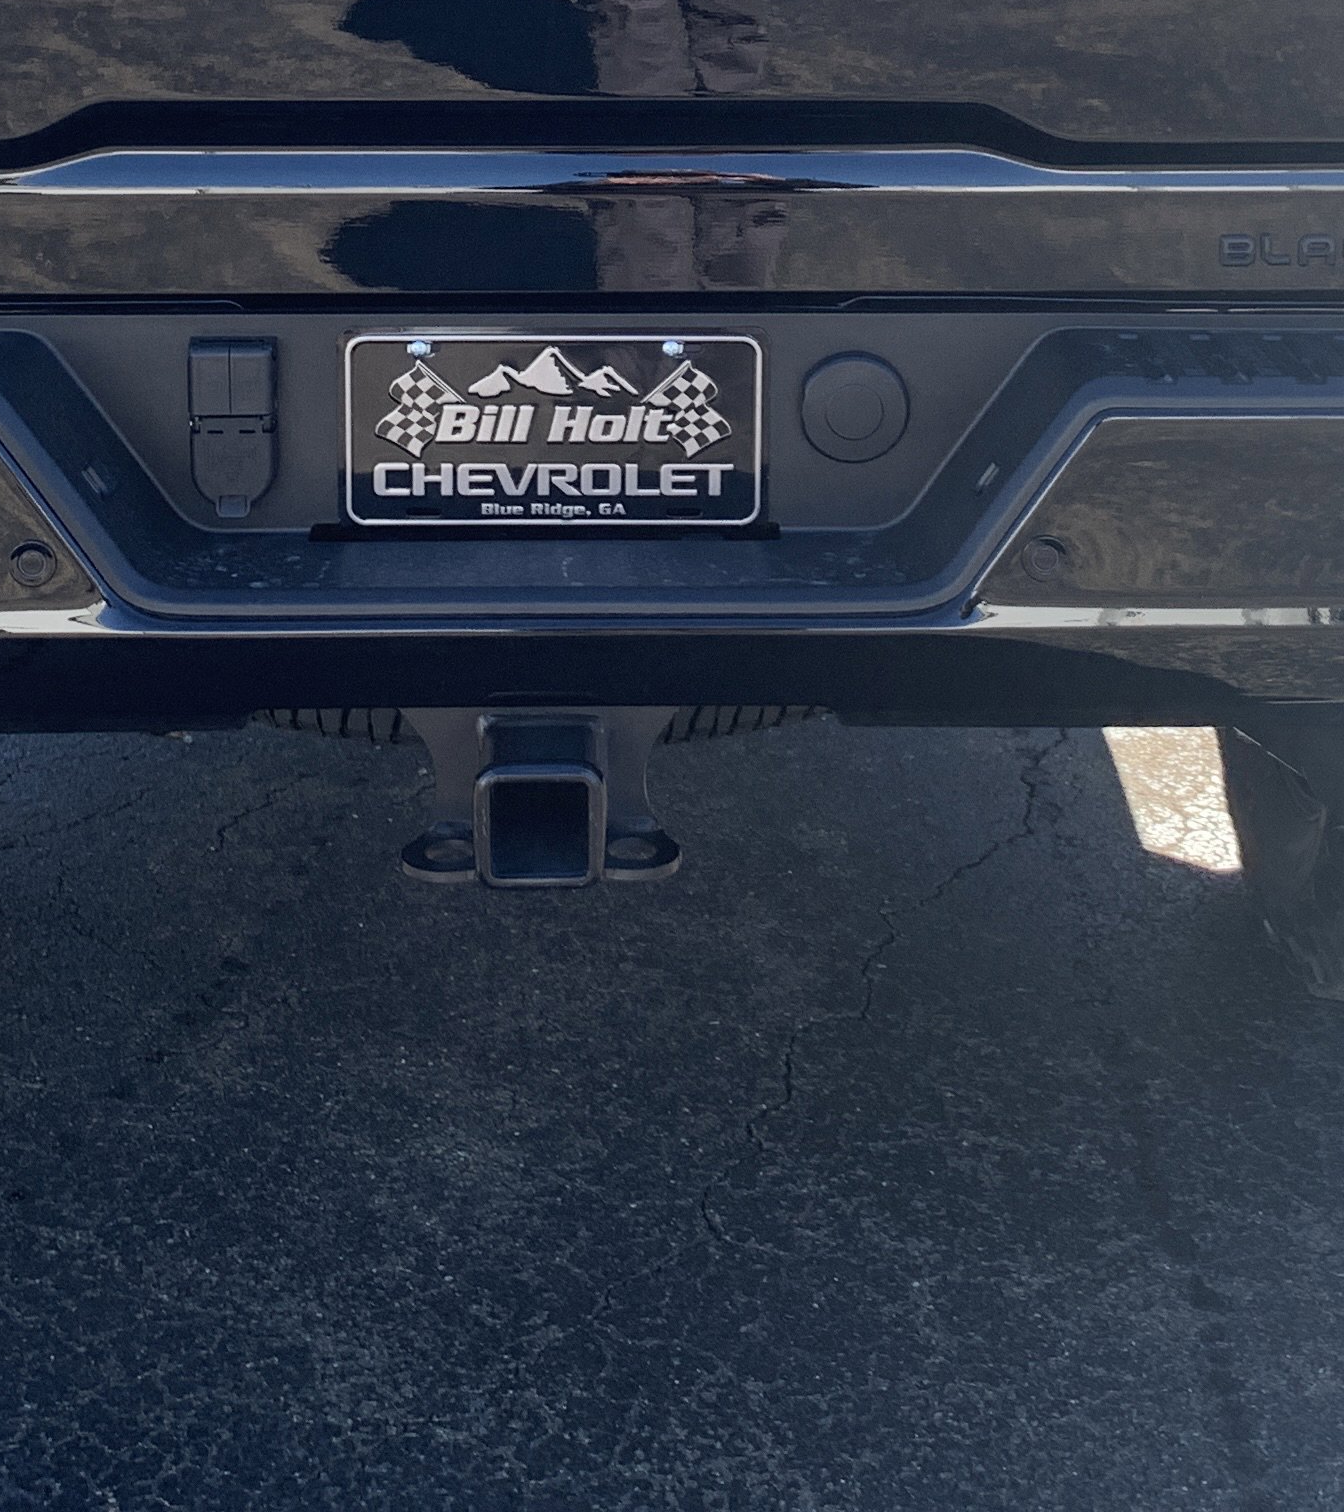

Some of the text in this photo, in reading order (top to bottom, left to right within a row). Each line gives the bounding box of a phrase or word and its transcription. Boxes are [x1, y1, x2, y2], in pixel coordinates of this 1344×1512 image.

[434, 404, 675, 443] Bill Holt
[372, 462, 735, 497] CHEVROLET
[480, 502, 627, 518] Blue Ridge, GA
